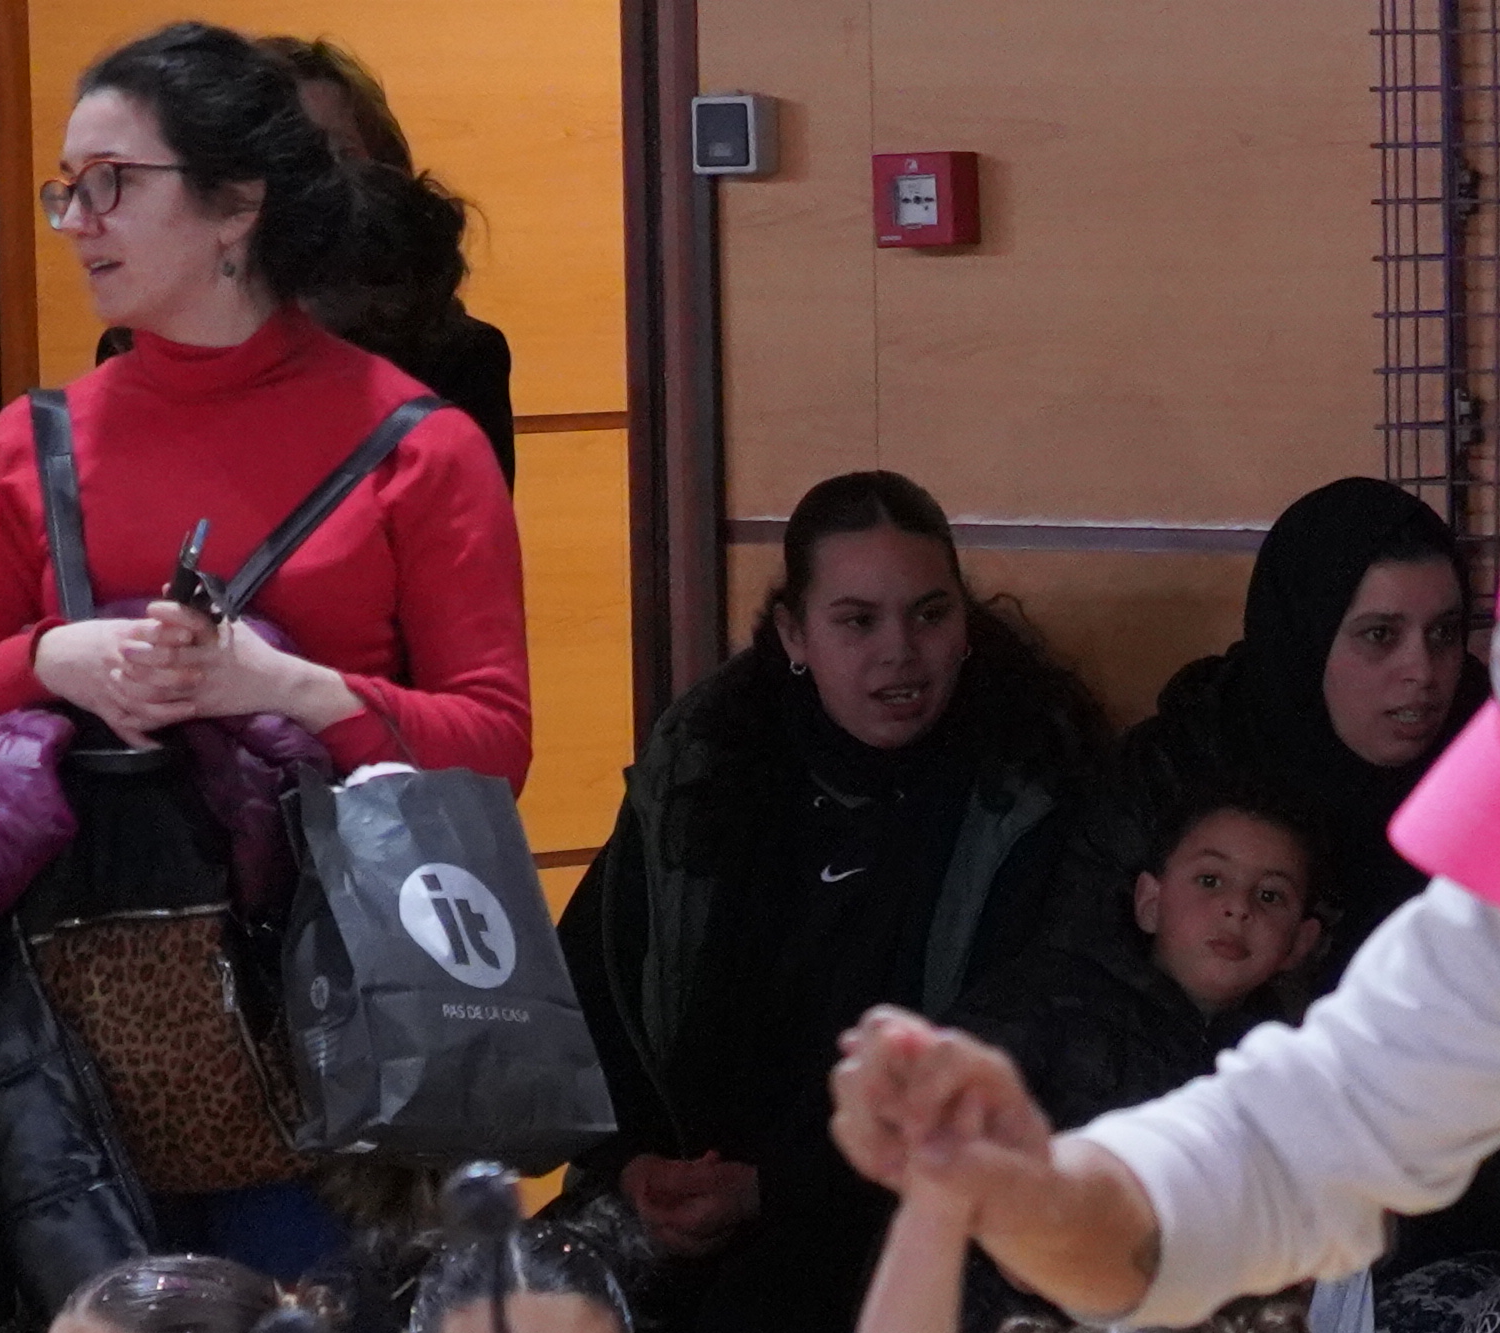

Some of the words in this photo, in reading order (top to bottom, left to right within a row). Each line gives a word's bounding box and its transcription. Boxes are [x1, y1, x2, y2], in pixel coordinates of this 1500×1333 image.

[420, 873, 502, 971] it
[442, 1003, 466, 1019] PAS
[467, 1005, 484, 1020] DE
[502, 1007, 531, 1024] CASA
